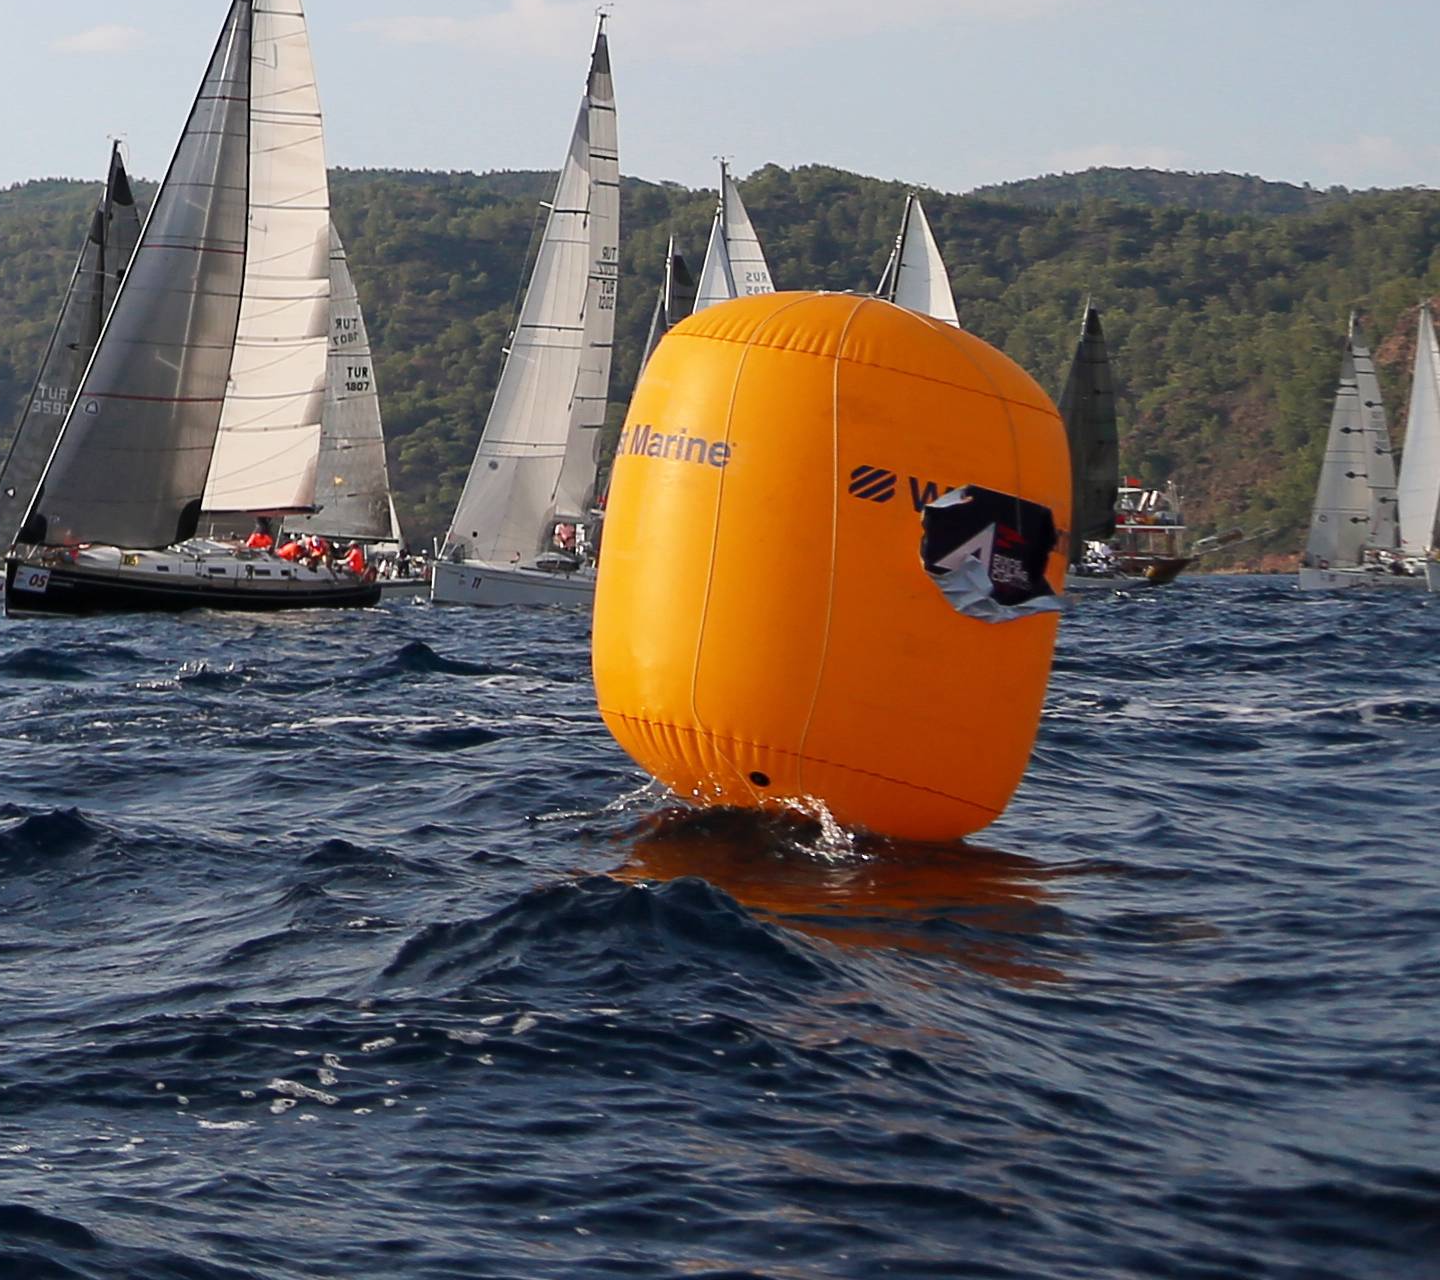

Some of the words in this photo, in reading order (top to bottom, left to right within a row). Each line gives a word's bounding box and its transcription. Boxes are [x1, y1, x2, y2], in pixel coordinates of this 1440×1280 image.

[347, 366, 368, 379] TUR
[38, 383, 68, 401] TUR
[345, 382, 370, 392] 1807
[629, 424, 732, 468] Marine
[30, 574, 48, 588] 05
